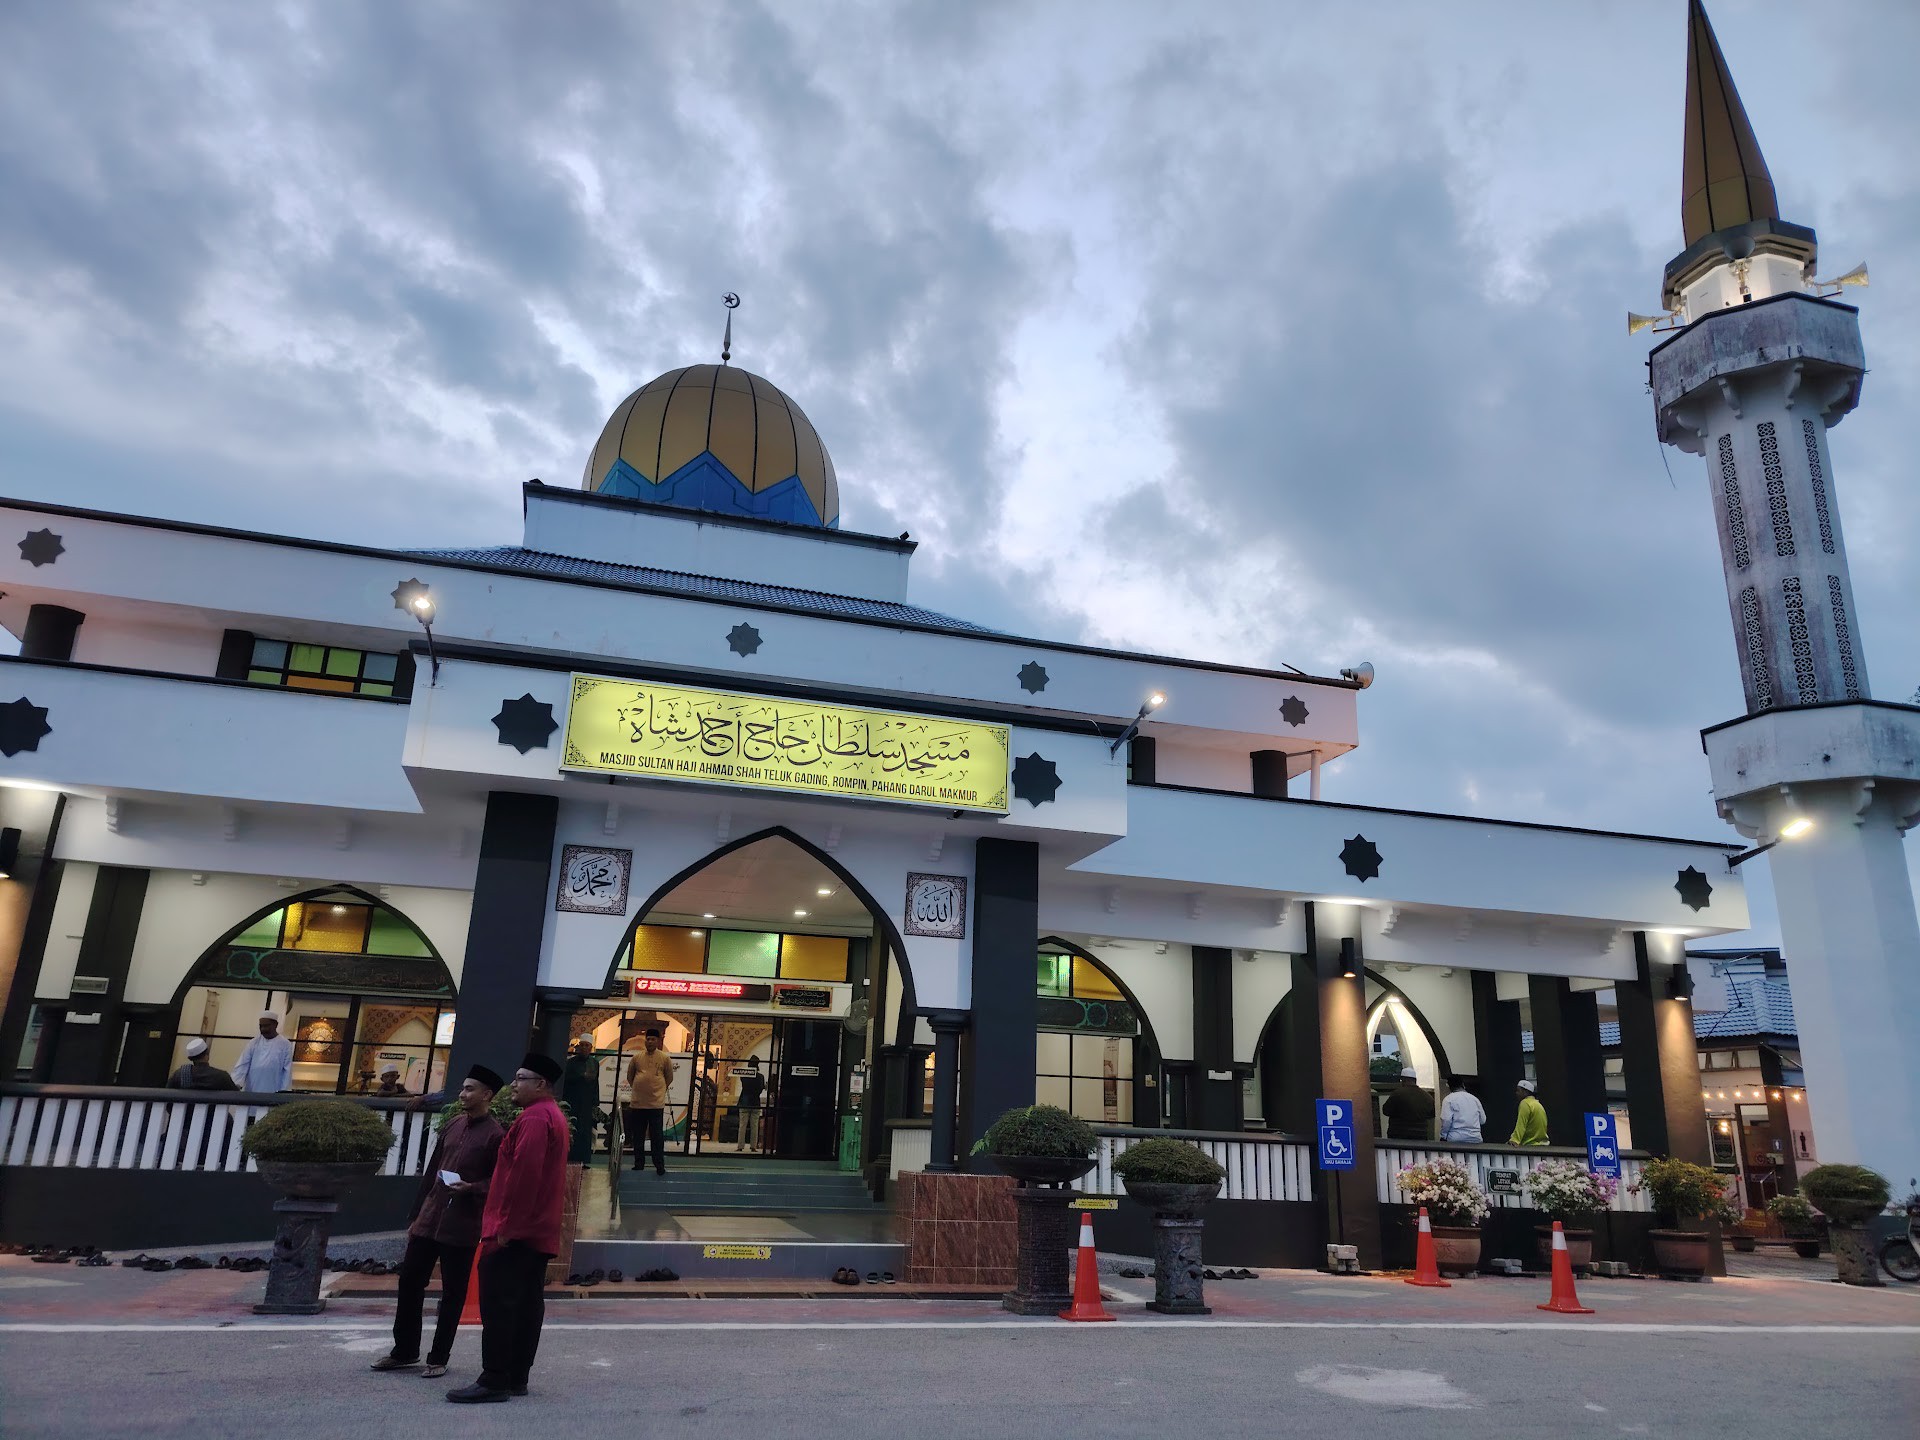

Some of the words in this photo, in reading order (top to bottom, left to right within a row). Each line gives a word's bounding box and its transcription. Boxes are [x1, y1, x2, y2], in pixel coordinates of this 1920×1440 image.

[599, 751, 636, 767] MASJID
[638, 756, 674, 771] SULTAN
[676, 759, 697, 773] HAJI
[699, 761, 734, 777] AHMAD
[735, 766, 761, 779] SHAH
[764, 768, 792, 782] TELUK
[794, 772, 830, 788] GADING,
[832, 776, 870, 791] ROMPIN,
[872, 780, 907, 794] PAHANG
[909, 784, 937, 798] DARUL
[939, 787, 978, 801] MAKMUR
[1326, 1105, 1343, 1126] P
[1593, 1116, 1608, 1136] P
